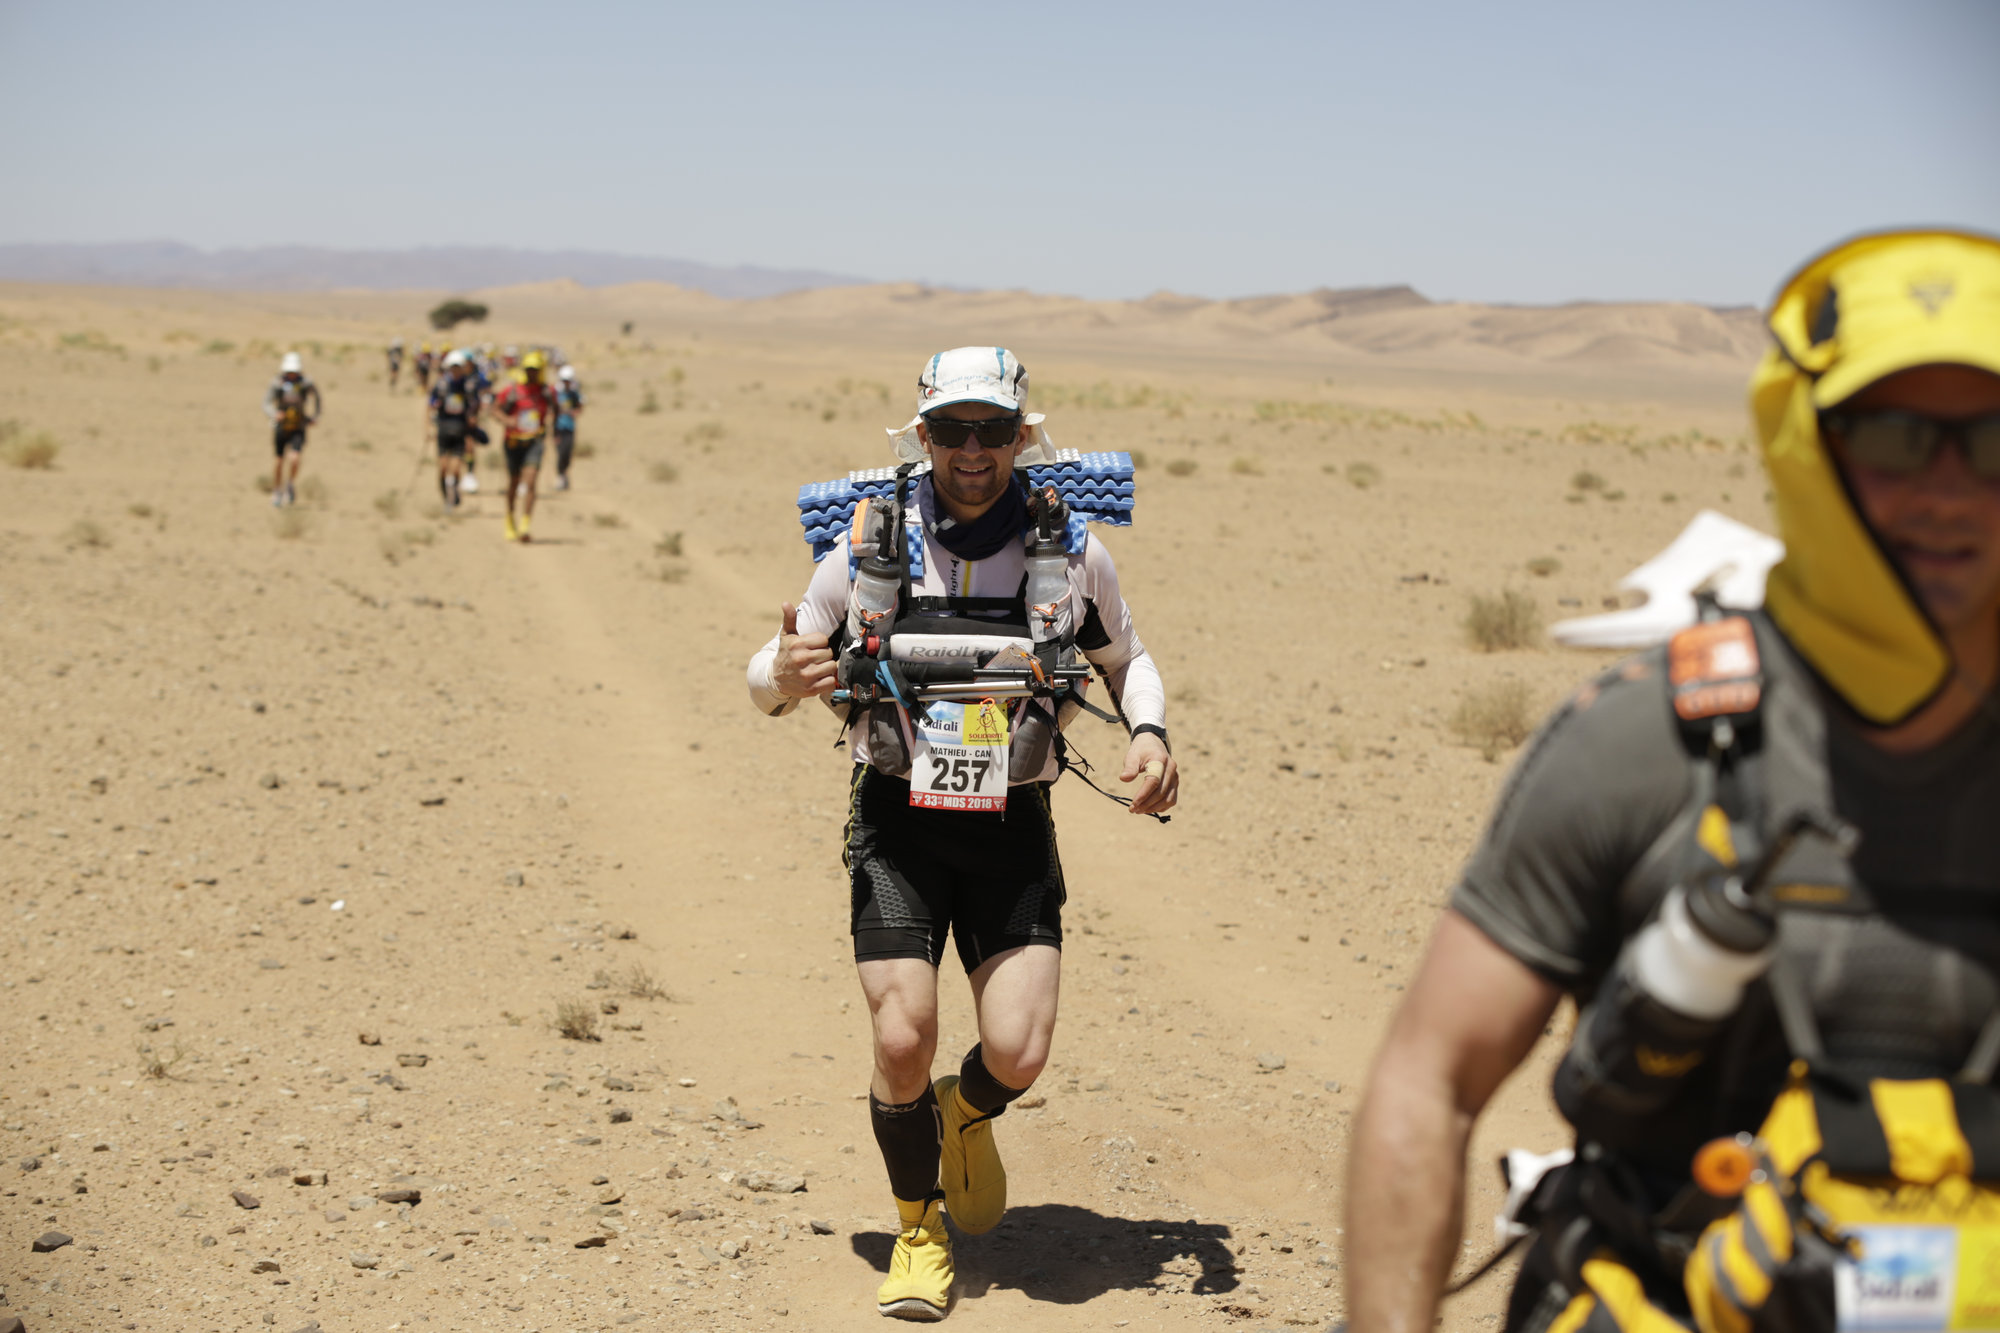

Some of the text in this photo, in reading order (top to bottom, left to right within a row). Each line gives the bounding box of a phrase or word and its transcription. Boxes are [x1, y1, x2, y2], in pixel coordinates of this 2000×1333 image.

[909, 646, 1000, 658] RaidLi
[944, 721, 958, 732] ali
[930, 747, 967, 757] MATHIEU
[975, 750, 991, 758] CAN
[930, 758, 989, 792] 257
[943, 796, 966, 808] MDS
[967, 797, 992, 809] 2018
